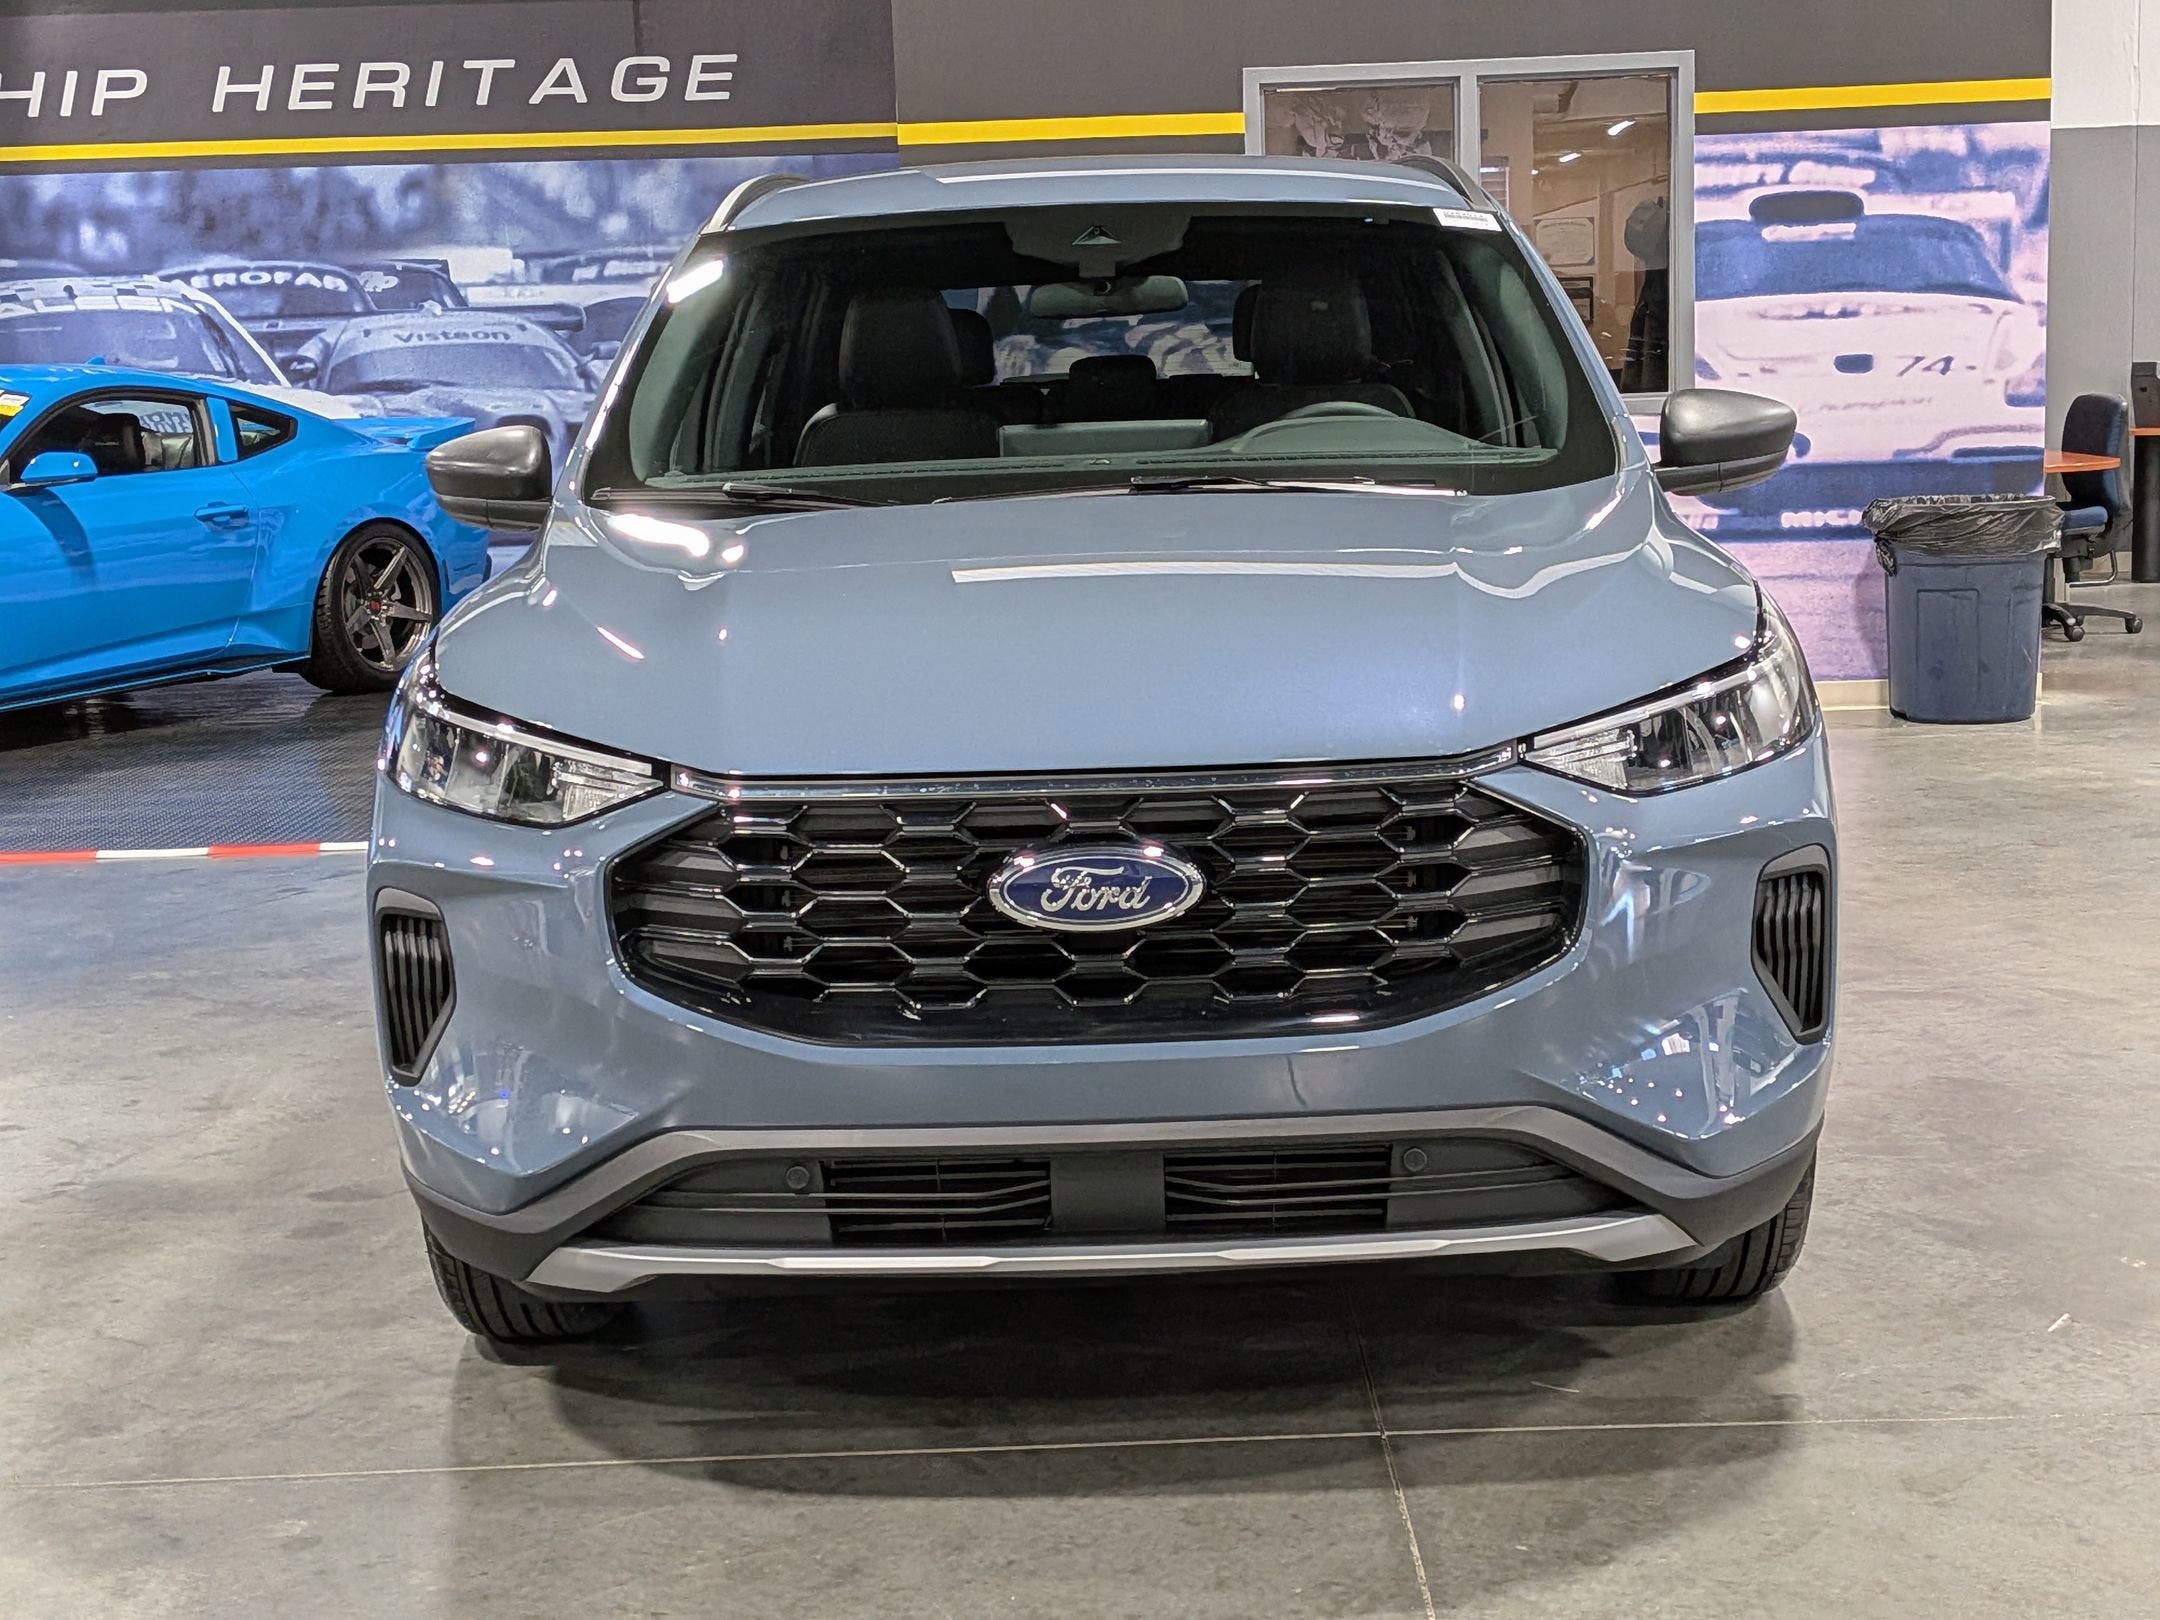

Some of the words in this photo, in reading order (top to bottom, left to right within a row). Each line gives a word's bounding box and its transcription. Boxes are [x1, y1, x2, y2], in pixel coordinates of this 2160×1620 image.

[0, 69, 148, 118] HIP
[212, 54, 739, 113] HERITAGE
[393, 330, 512, 343] Visteon
[1040, 865, 1152, 912] Ford
